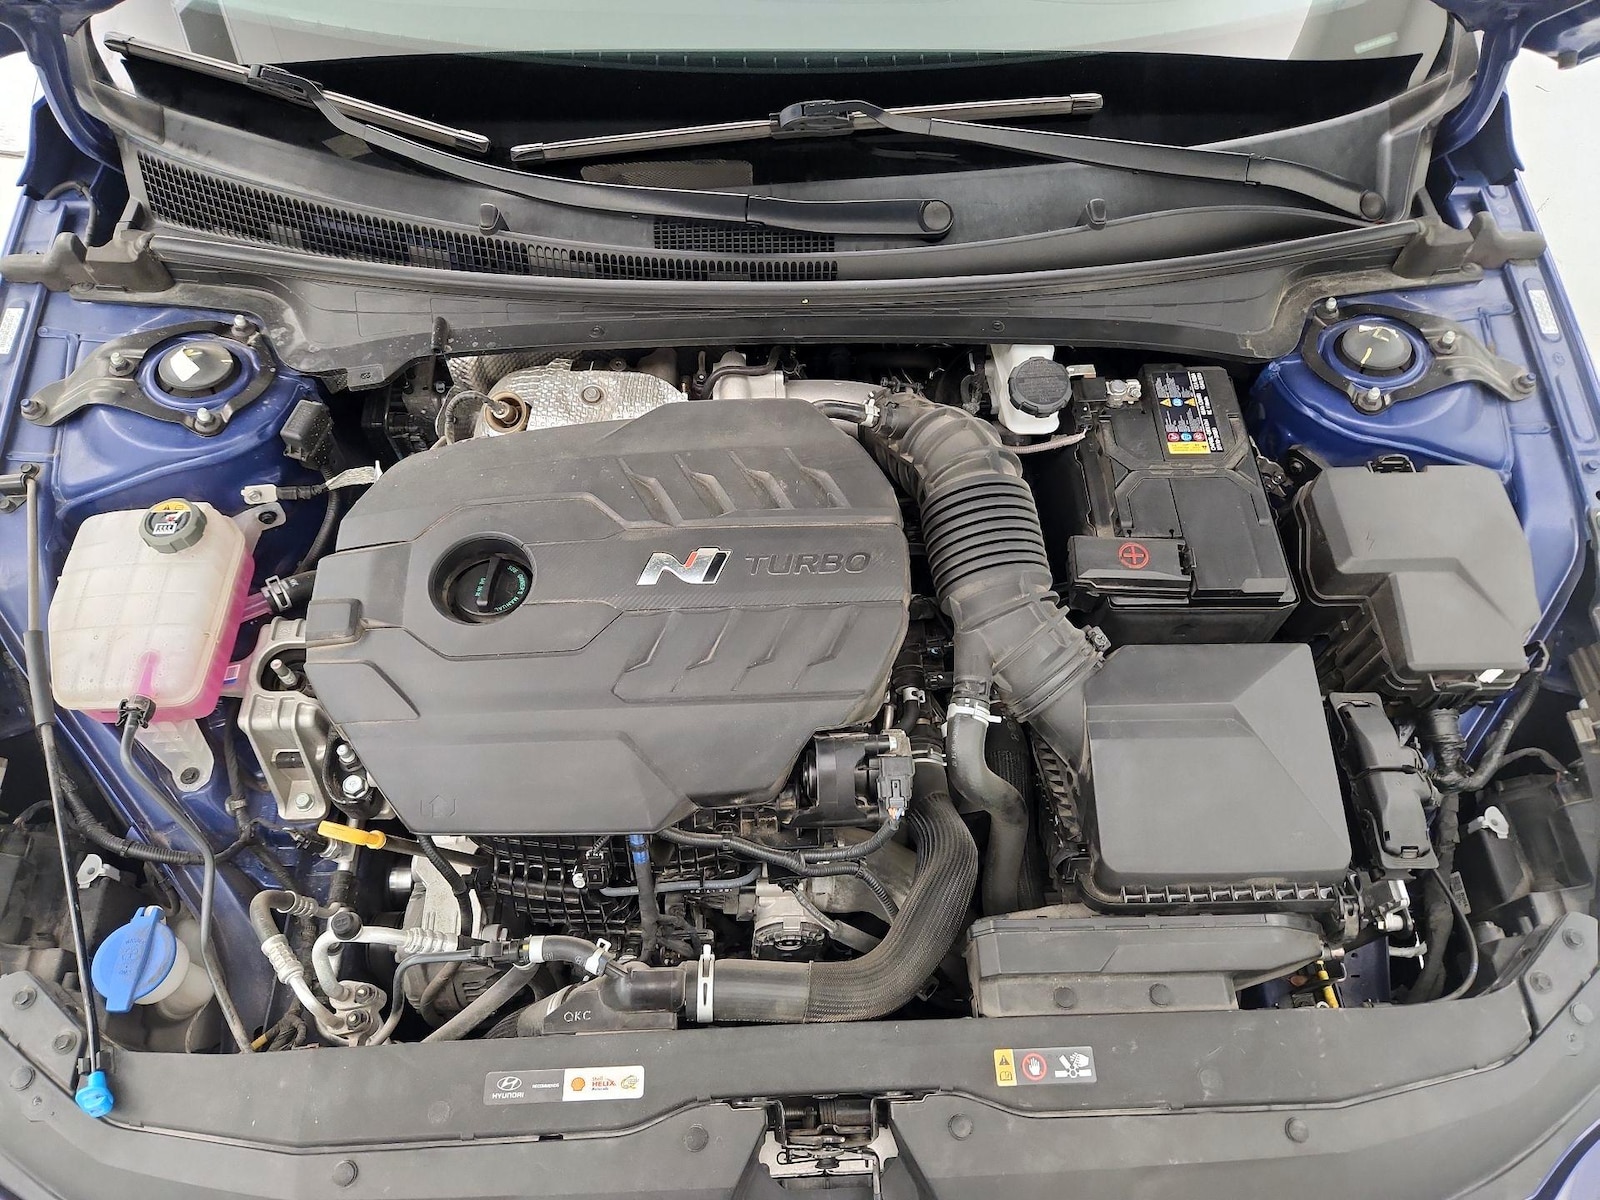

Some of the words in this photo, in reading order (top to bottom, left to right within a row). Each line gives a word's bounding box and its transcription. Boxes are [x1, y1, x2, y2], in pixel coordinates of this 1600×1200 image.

[507, 565, 519, 574] SEE
[745, 552, 870, 576] TURBO
[494, 596, 519, 612] MANUAL
[492, 1091, 525, 1099] HYUNDAI
